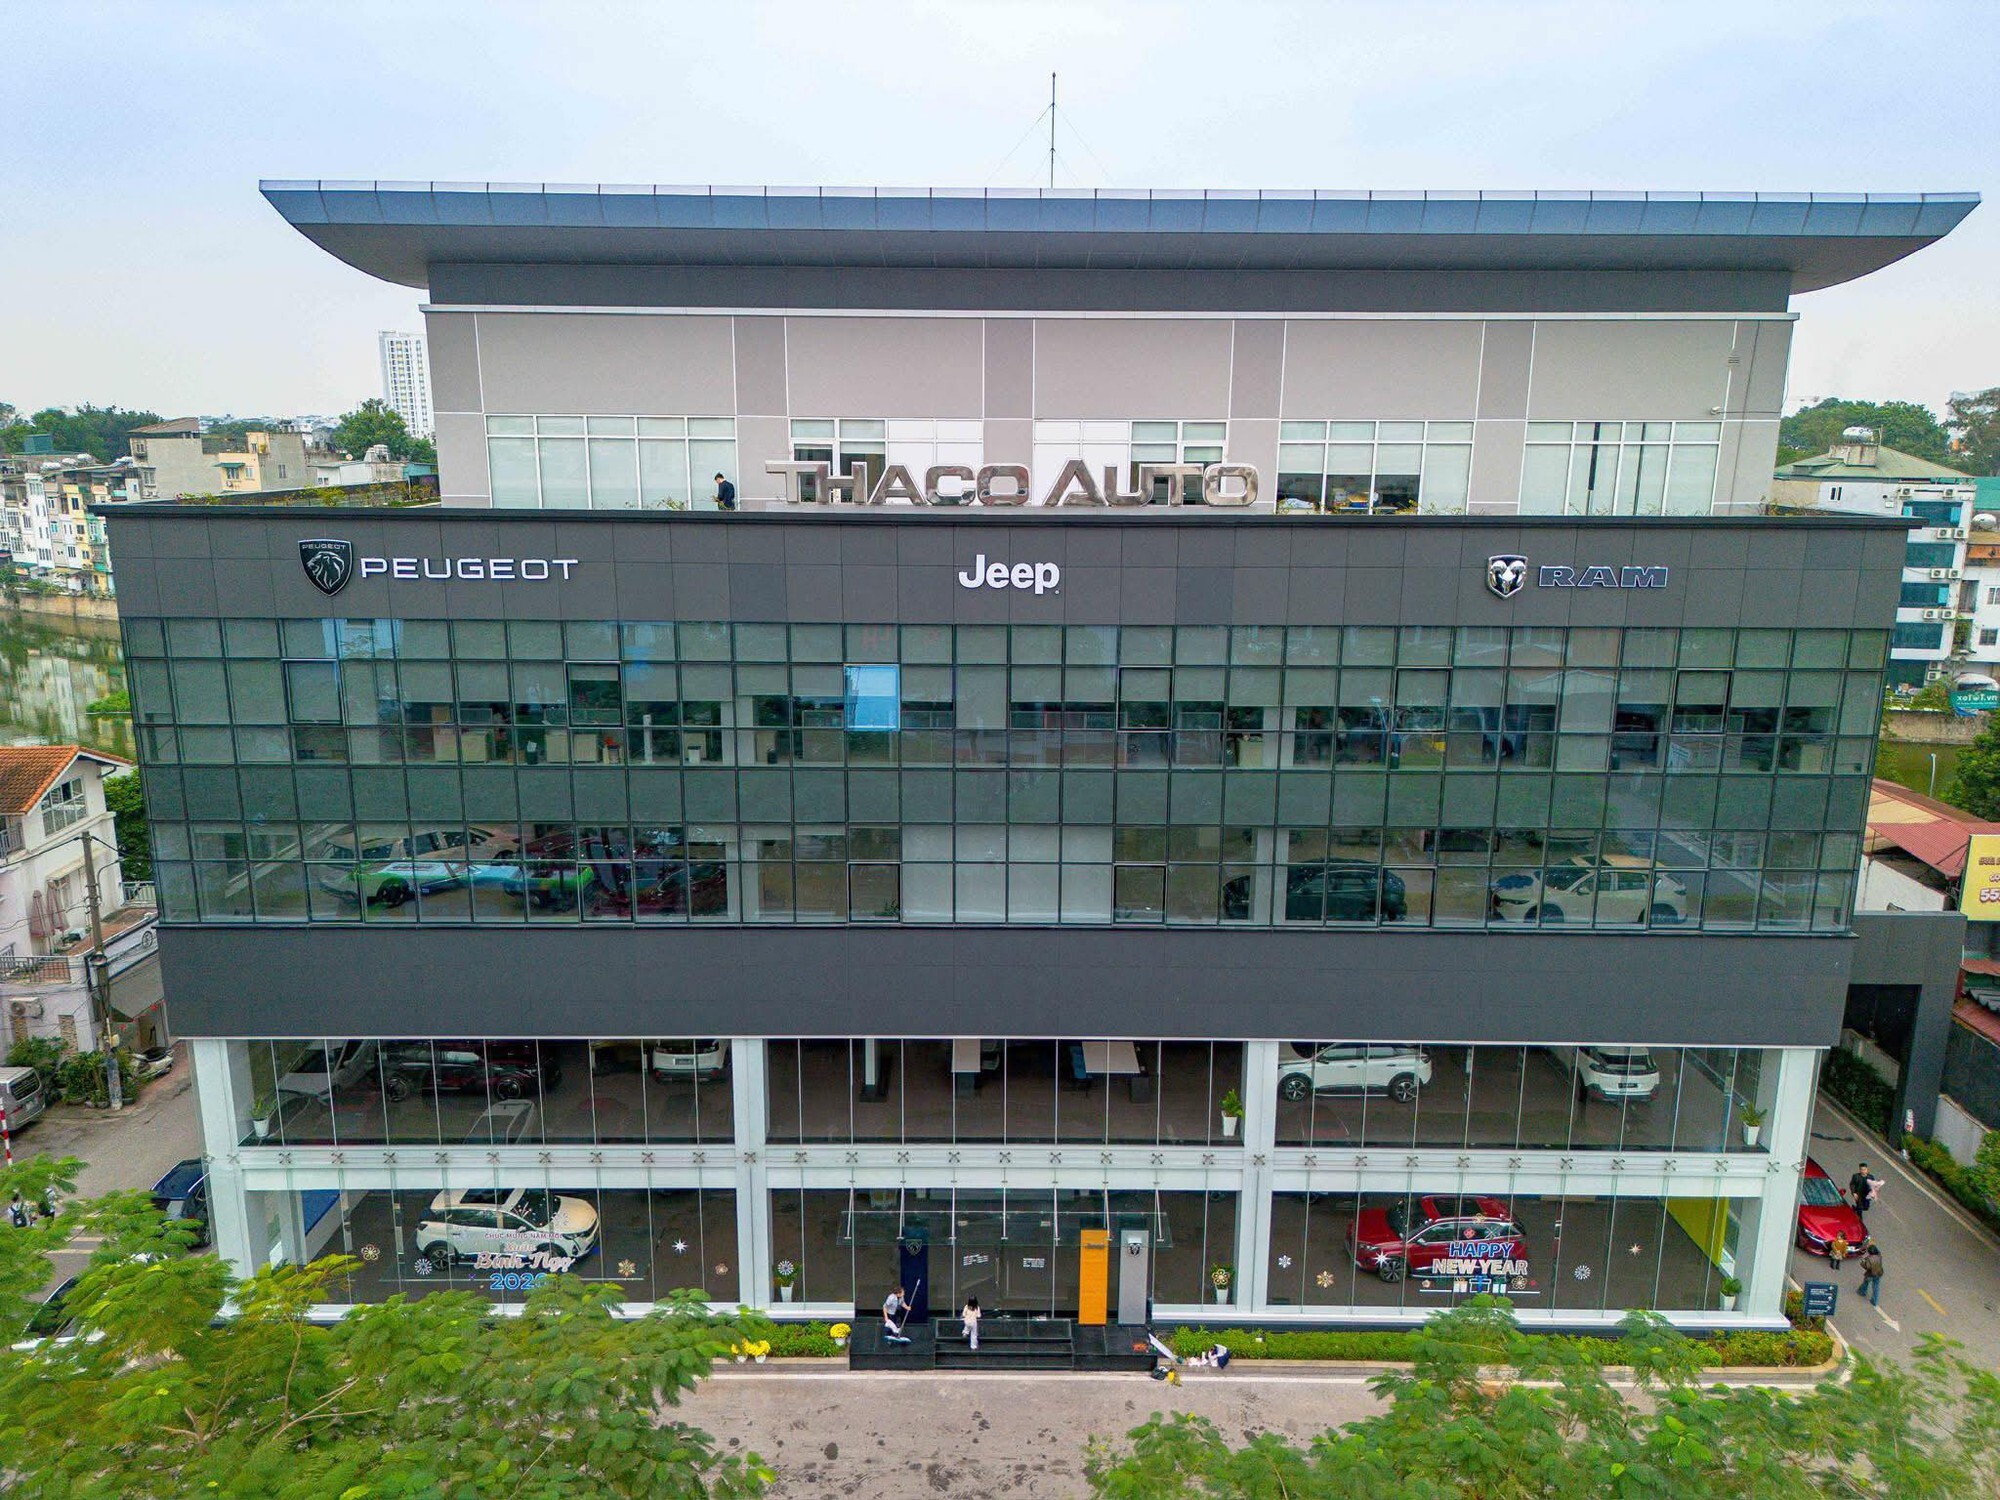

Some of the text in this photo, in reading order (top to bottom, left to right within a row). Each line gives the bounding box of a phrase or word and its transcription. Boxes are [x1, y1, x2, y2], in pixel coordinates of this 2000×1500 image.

[765, 457, 1259, 507] THACO AUTO
[360, 557, 579, 580] PEUGEOT
[958, 553, 1060, 595] Jeep
[1538, 565, 1669, 588] RAM
[1449, 1241, 1514, 1258] HAPPY
[1432, 1258, 1528, 1276] NEW YEAR
